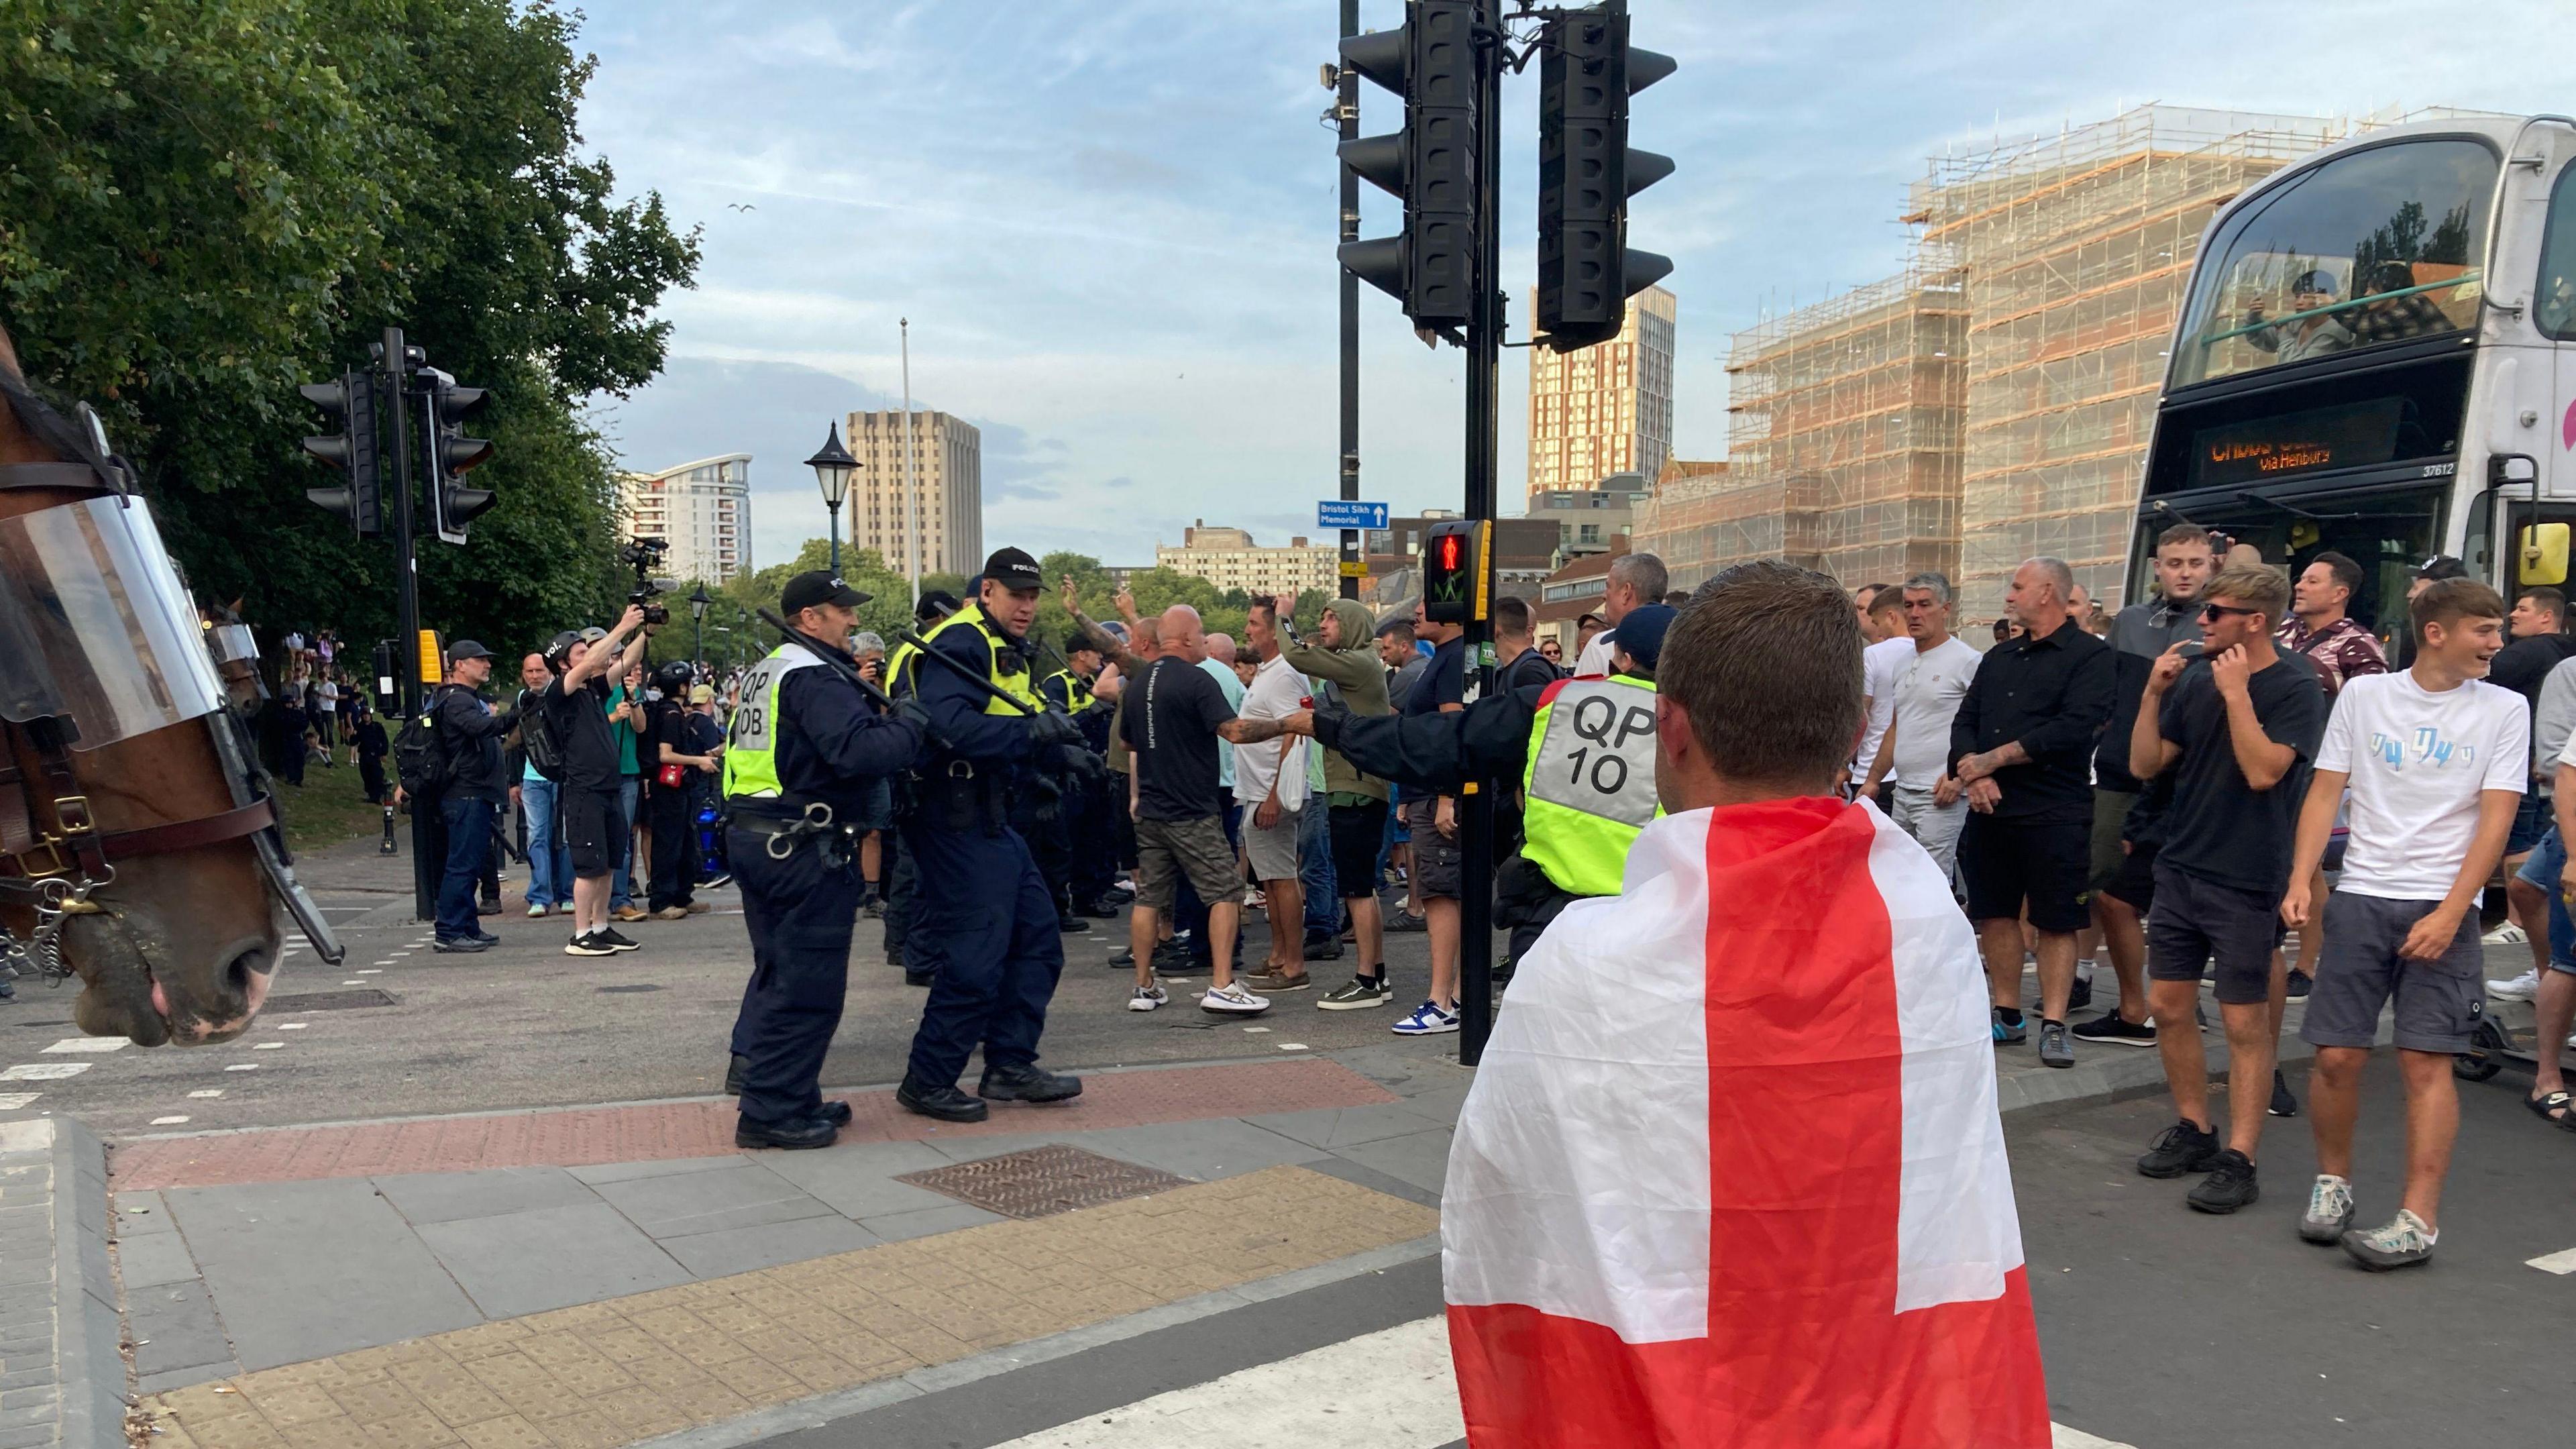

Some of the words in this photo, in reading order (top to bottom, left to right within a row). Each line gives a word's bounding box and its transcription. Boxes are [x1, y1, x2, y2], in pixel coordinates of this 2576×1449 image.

[2423, 464, 2454, 478] 37612
[1320, 504, 1350, 514] Bristol
[1351, 505, 1370, 514] Sikh
[1320, 515, 1360, 525] Memorial
[544, 641, 562, 658] vol.
[741, 672, 769, 705] QP
[1146, 702, 1155, 749] ARMOUR
[1572, 695, 1656, 749] QP
[1567, 747, 1628, 795] 10
